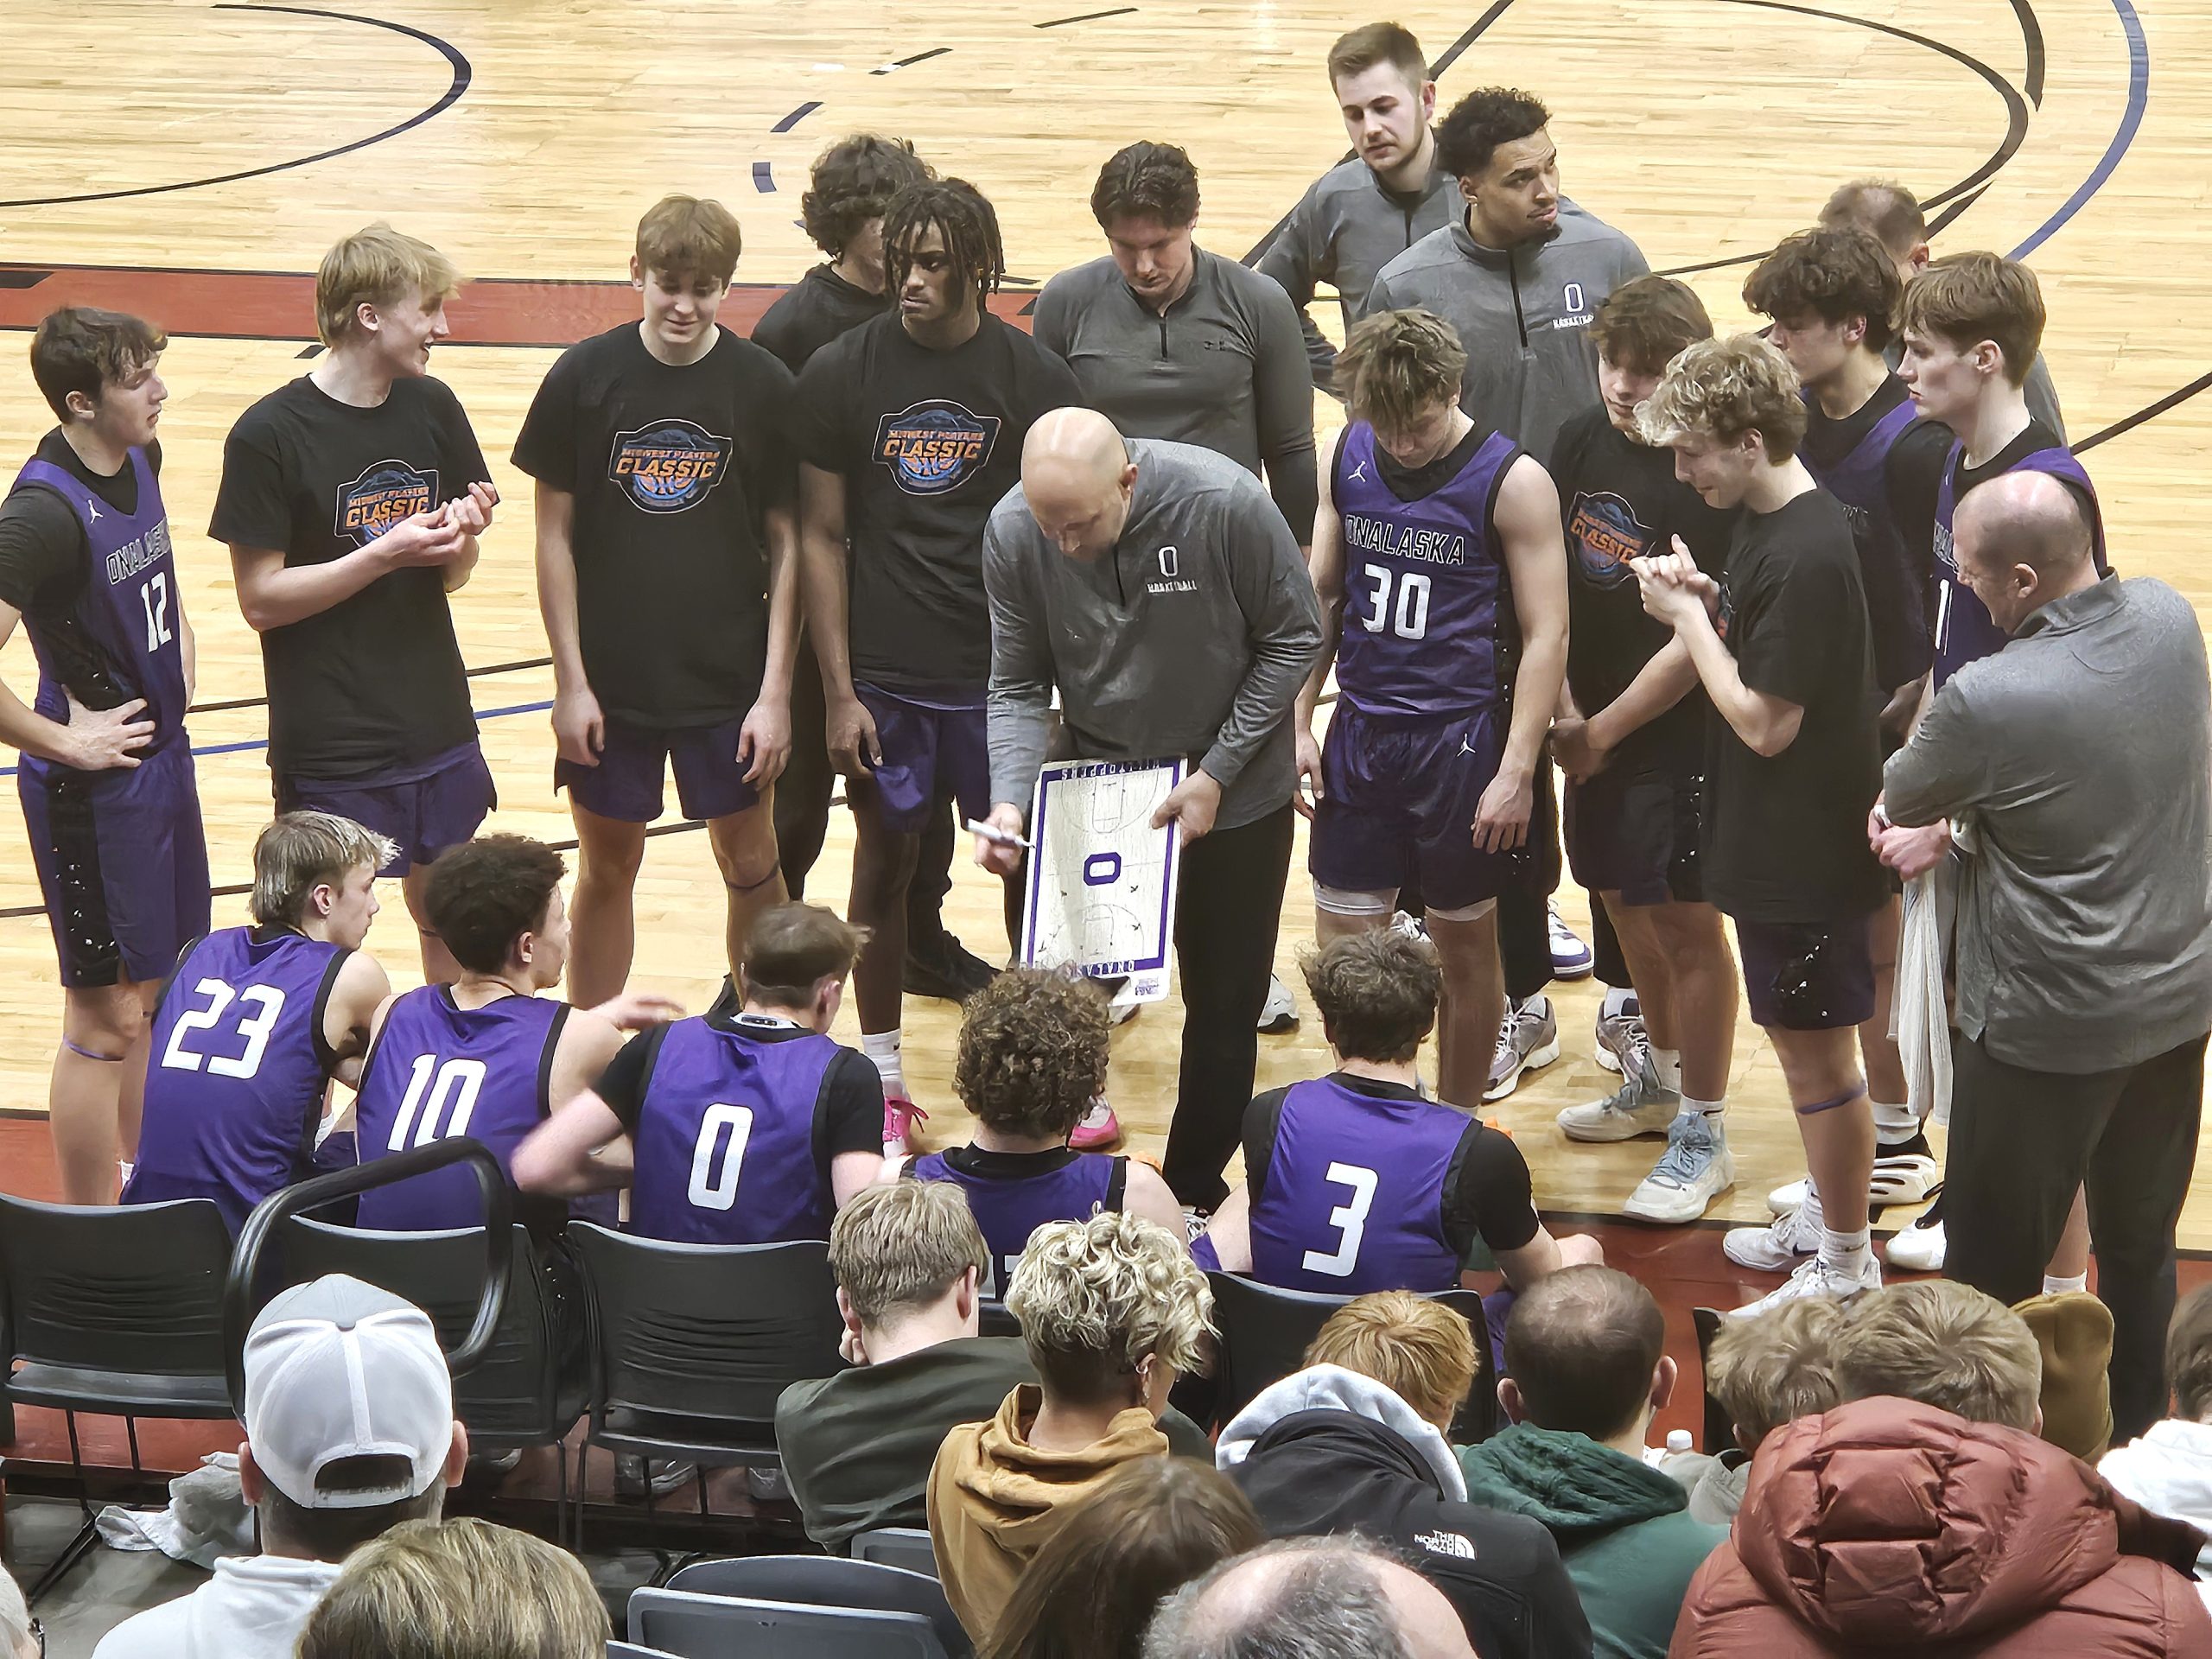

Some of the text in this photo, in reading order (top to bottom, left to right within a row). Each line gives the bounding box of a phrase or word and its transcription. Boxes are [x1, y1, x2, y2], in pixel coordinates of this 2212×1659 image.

[616, 457, 716, 478] CLASSIC
[883, 439, 982, 459] CLASSIC
[346, 496, 429, 527] CLASSIC
[1345, 514, 1465, 566] ONALASKA
[141, 571, 172, 652] 12
[1362, 563, 1431, 639] 30
[162, 977, 286, 1079] 23
[388, 1054, 486, 1153] 10
[688, 1103, 753, 1211] 0
[1302, 1161, 1379, 1277] 3
